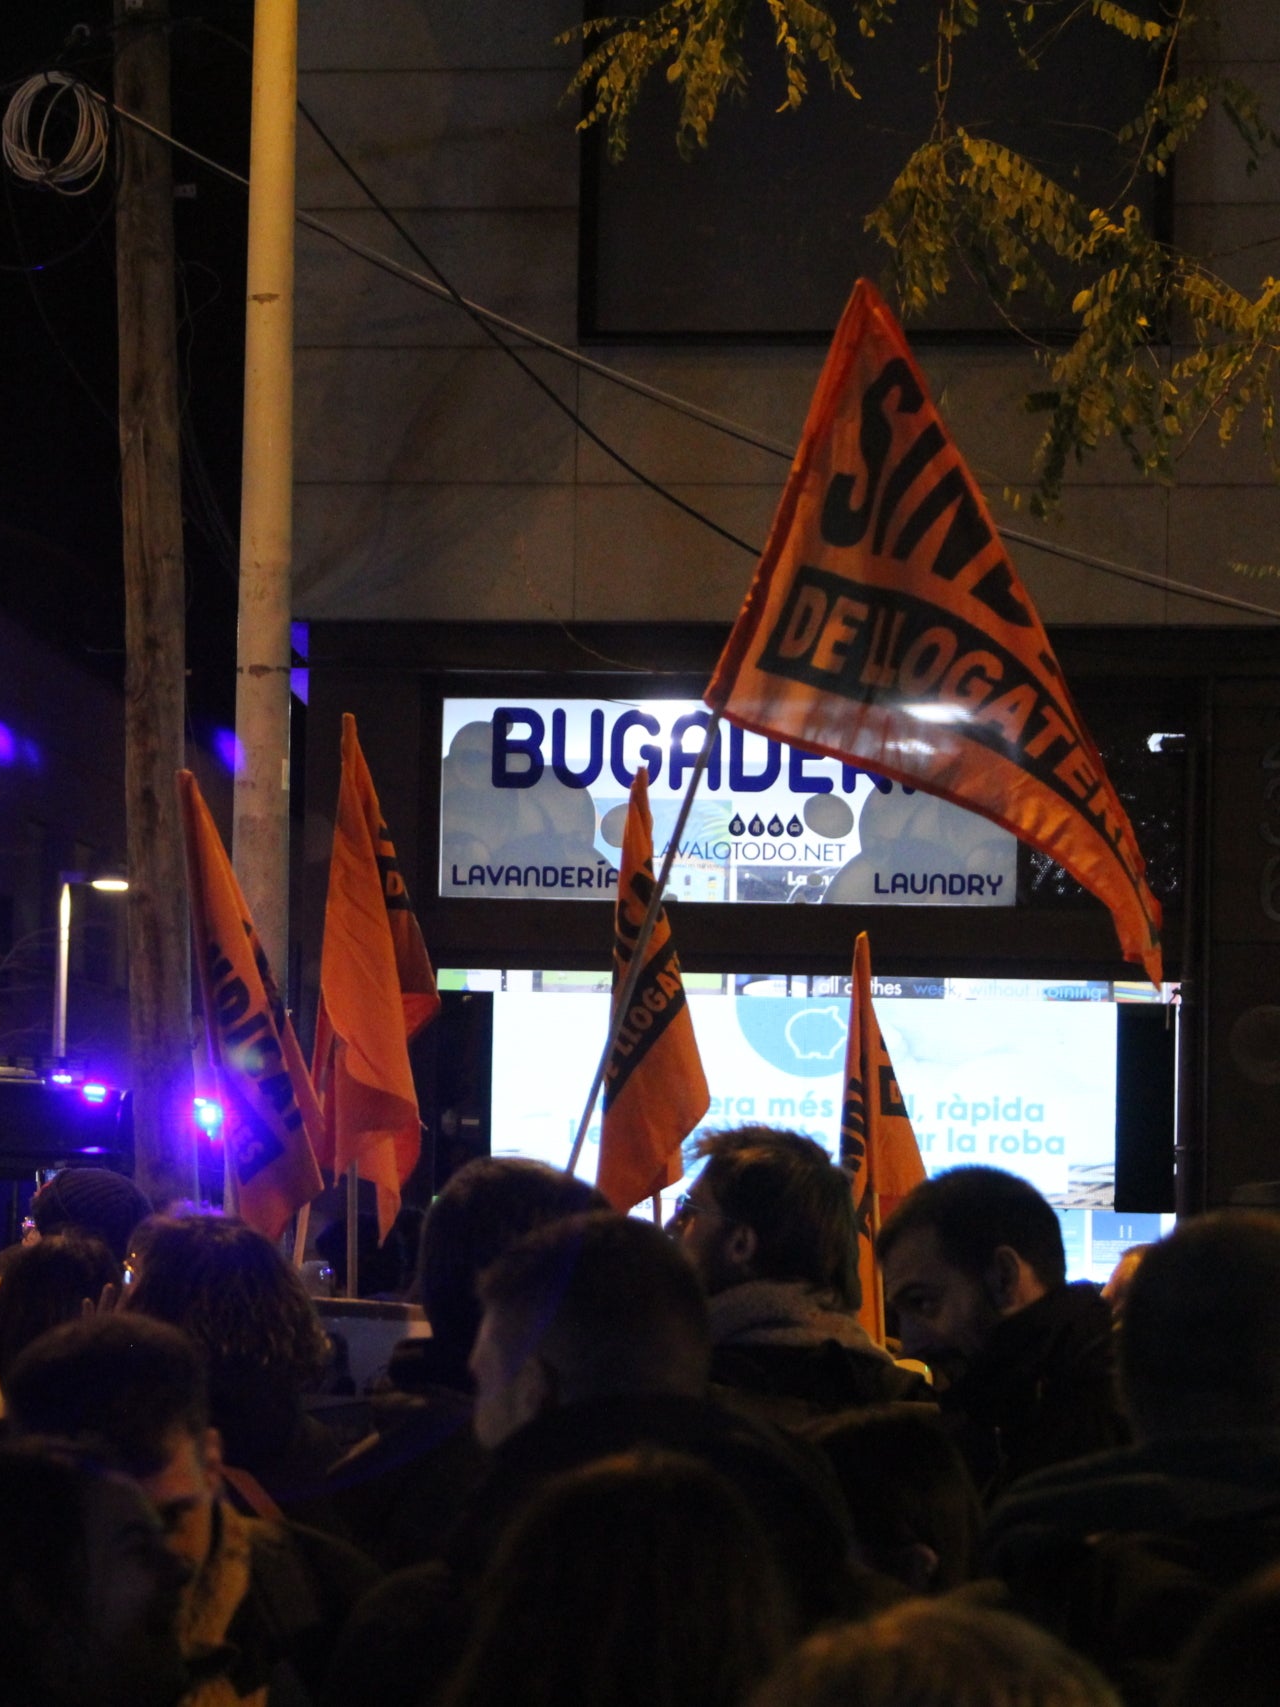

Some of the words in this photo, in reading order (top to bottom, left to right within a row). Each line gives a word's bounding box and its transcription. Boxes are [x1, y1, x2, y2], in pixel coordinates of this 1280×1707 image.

[777, 584, 869, 673] DE
[859, 606, 1138, 885] LLOGATER
[492, 707, 915, 795] BUGADE
[452, 860, 619, 889] LAVANDERÍA
[874, 873, 1003, 896] LAUNDRY
[844, 976, 903, 995] cthes
[768, 1090, 834, 1117] més
[936, 1093, 1045, 1127] ràpida
[947, 1127, 976, 1153] la
[988, 1129, 1065, 1155] roba
